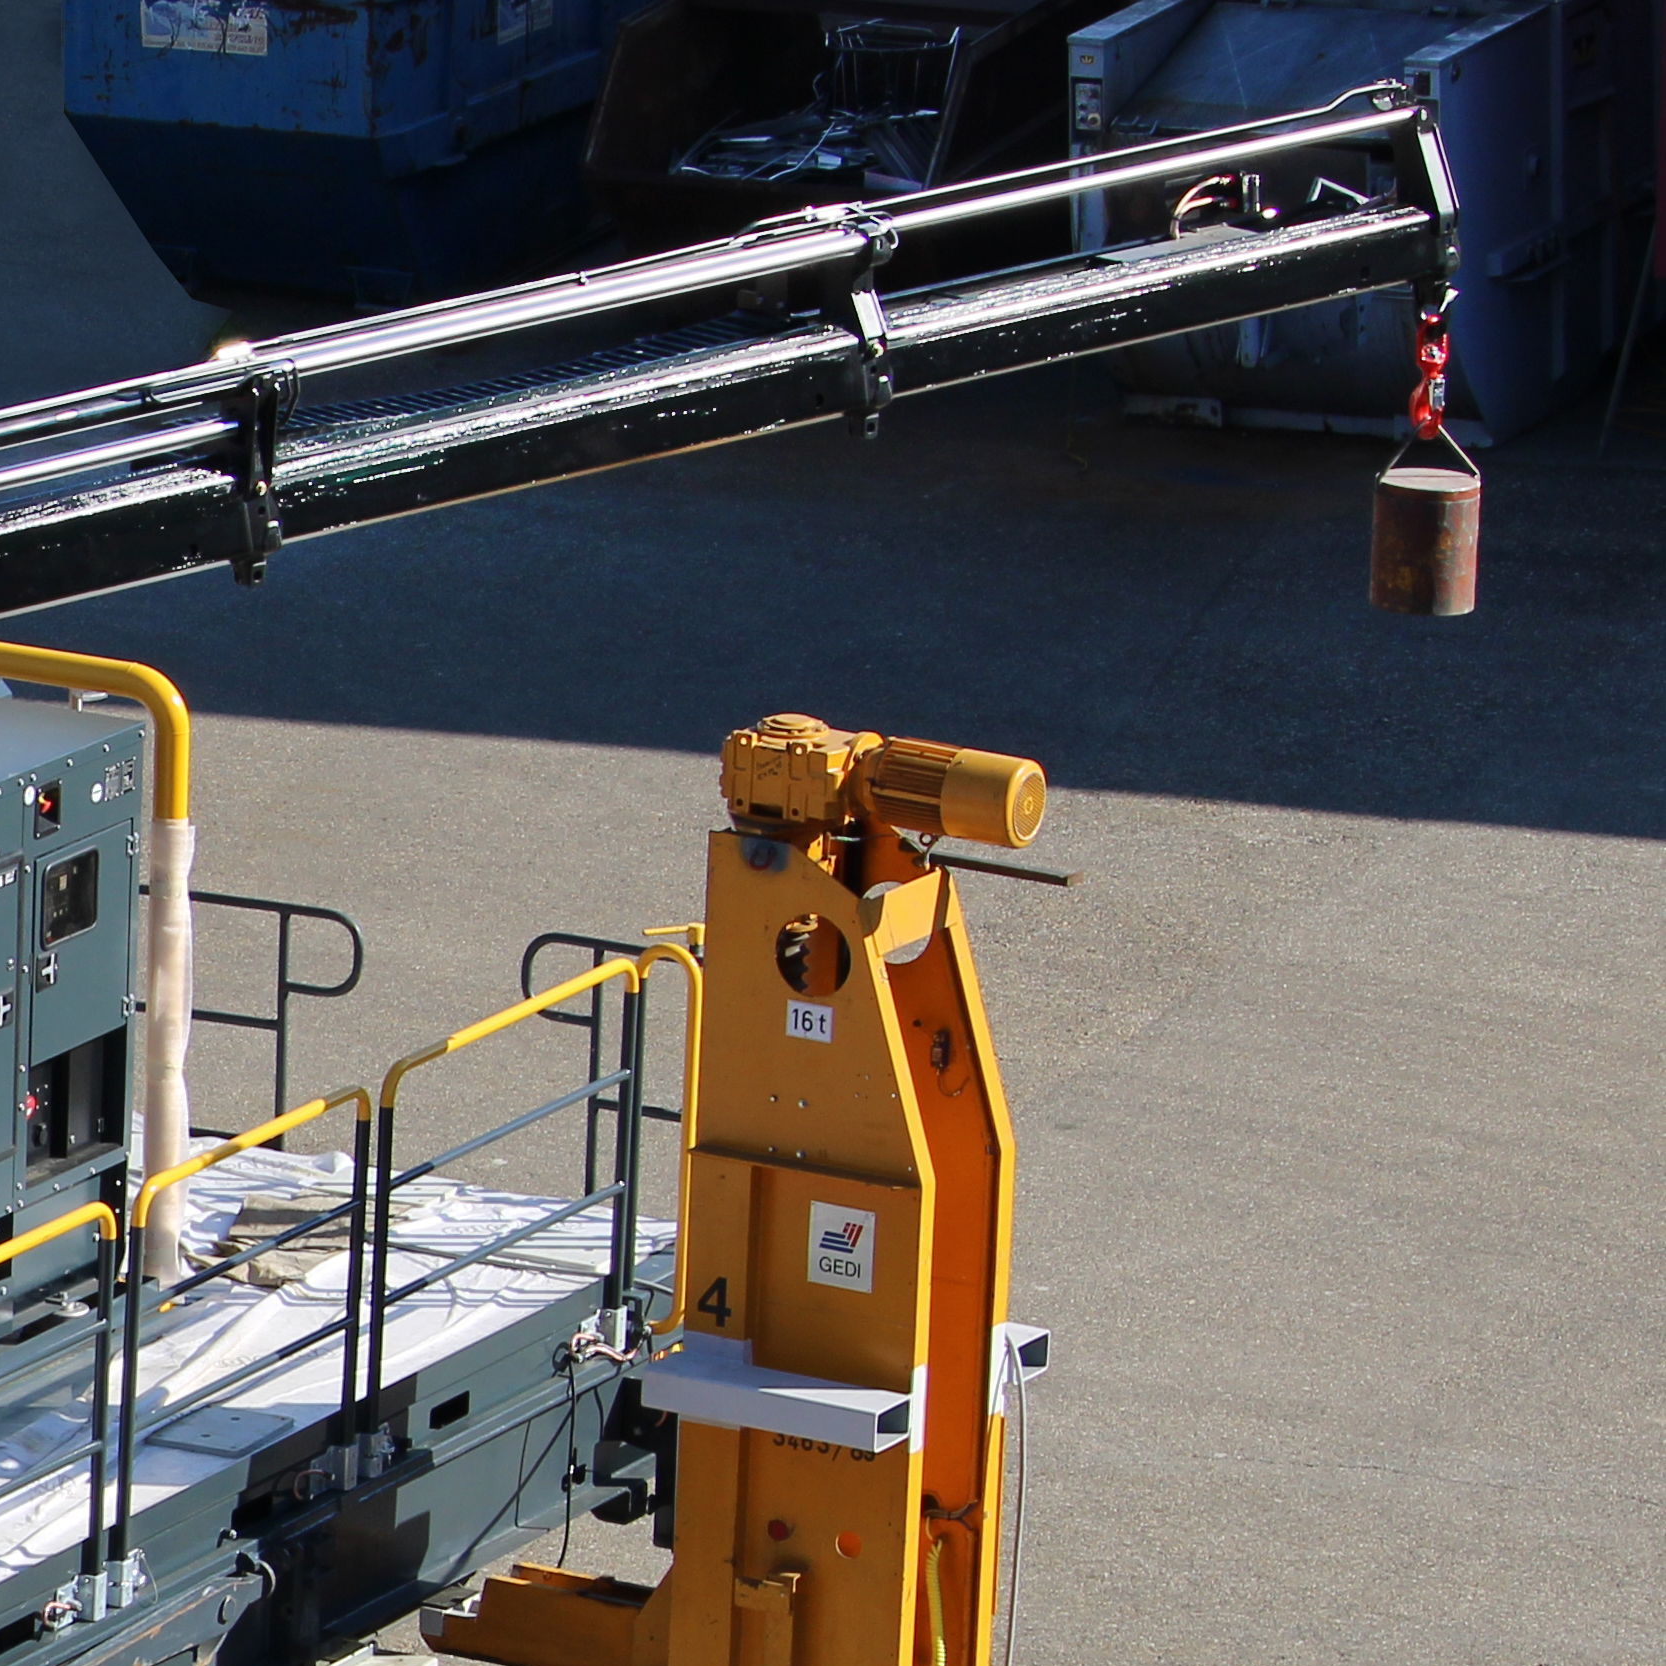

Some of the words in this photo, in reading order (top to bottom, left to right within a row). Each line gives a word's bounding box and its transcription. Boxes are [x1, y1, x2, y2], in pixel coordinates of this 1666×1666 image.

[792, 1008, 814, 1032] 16
[818, 1014, 827, 1035] t
[818, 1256, 861, 1279] GEDI
[696, 1276, 732, 1328] 4
